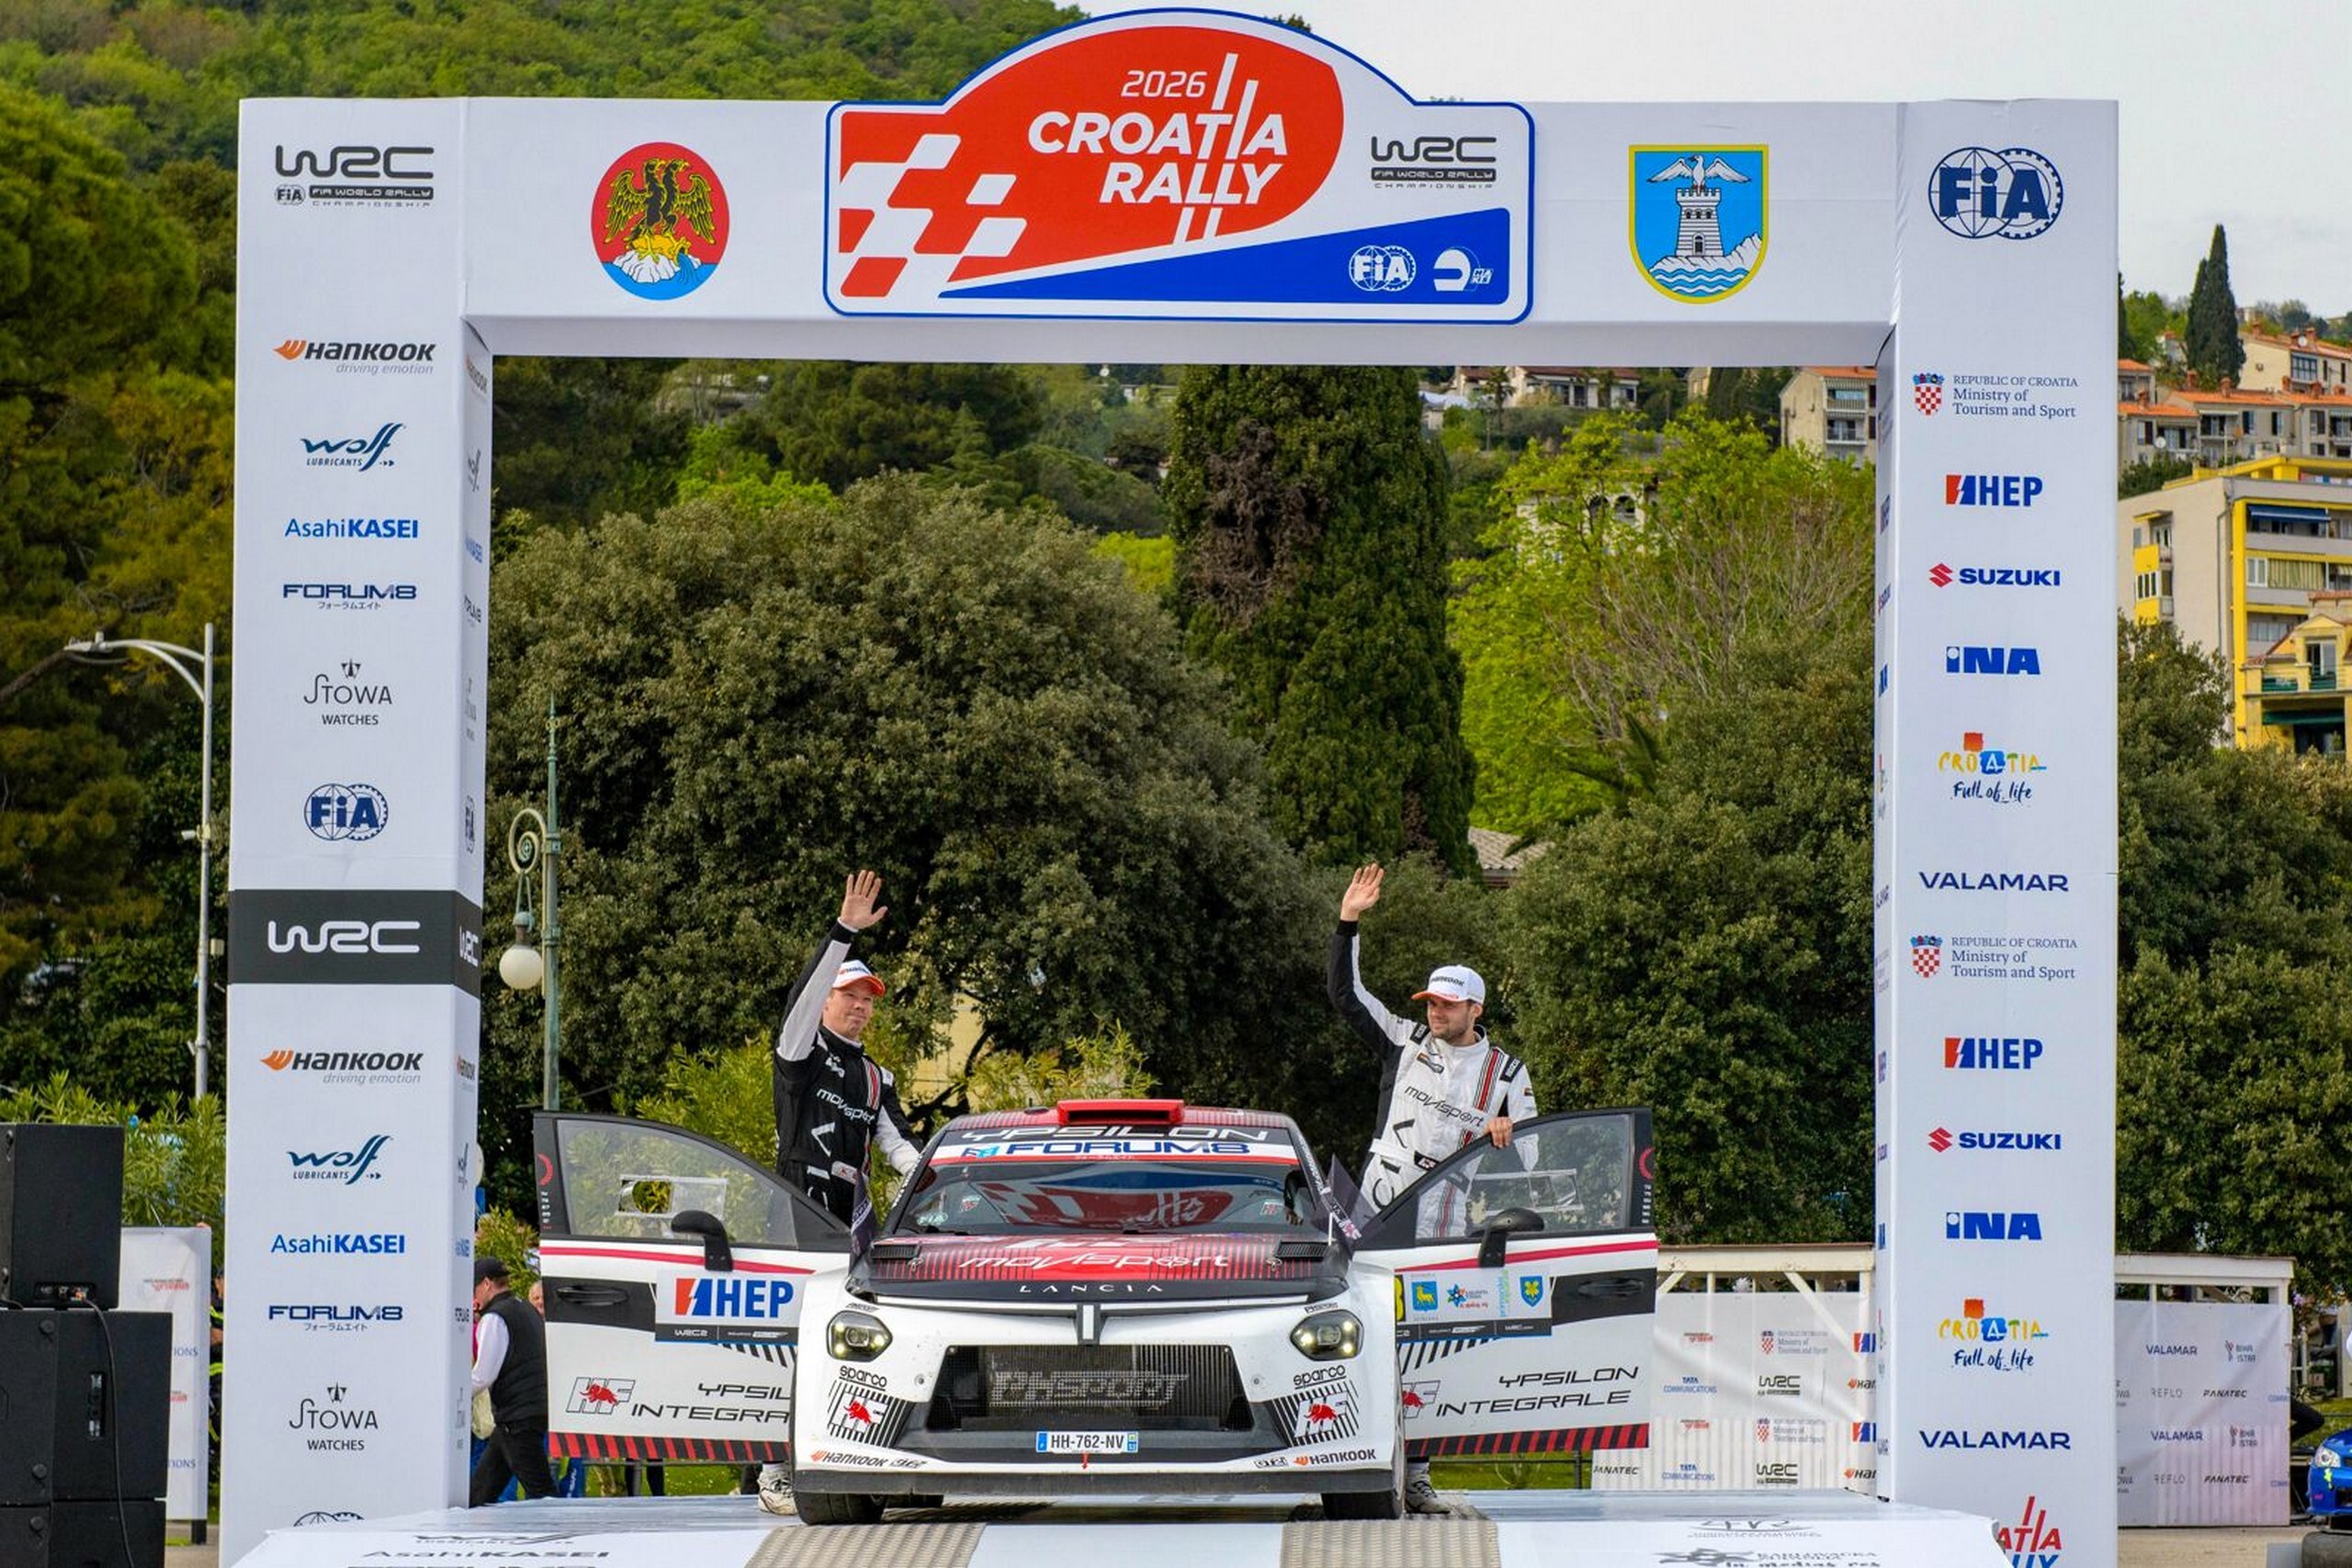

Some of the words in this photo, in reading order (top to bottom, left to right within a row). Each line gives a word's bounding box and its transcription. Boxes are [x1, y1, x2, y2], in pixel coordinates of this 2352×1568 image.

[1121, 70, 1207, 98] 2026
[1027, 111, 1288, 160] CROATIA
[1372, 136, 1498, 164] WRC
[275, 144, 435, 179] WRC
[1397, 171, 1444, 179] WORLD
[335, 187, 382, 197] WORLD
[385, 188, 431, 197] RALLY
[1100, 162, 1284, 207] RALLY
[336, 365, 379, 377] driving
[382, 365, 434, 375] emotion
[1953, 375, 2008, 387] REPUBLIC
[2010, 376, 2026, 387] OF
[2028, 377, 2079, 388] CROATIA
[1953, 389, 2012, 403] Ministry
[2014, 389, 2029, 401] of
[1953, 403, 2009, 417] Tourism
[2011, 404, 2037, 417] and
[2040, 405, 2076, 420] Sport
[307, 458, 363, 467] LUBRICANTS
[1979, 475, 2043, 507] HEP
[1959, 568, 2062, 587] SUZUKI
[283, 584, 417, 600] FORUM8
[322, 715, 379, 726] WATCHES
[1939, 750, 2048, 775] CROATIA
[1953, 781, 1983, 799] Full
[1985, 782, 2002, 802] of
[2008, 781, 2033, 802] life
[1919, 872, 2069, 893] VALAMAR
[267, 920, 421, 953] WRC
[1951, 937, 2007, 948] REPUBLIC
[2009, 937, 2025, 948] OF
[2027, 938, 2078, 949] CROATIA
[1951, 950, 2010, 964] Ministry
[2013, 950, 2028, 963] of
[1951, 965, 2007, 978] Tourism
[2010, 965, 2035, 979] and
[2039, 966, 2075, 981] Sport
[1978, 1037, 2043, 1070] HEP
[323, 1074, 366, 1086] driving
[369, 1074, 421, 1084] emotion
[962, 1126, 1268, 1141] YPSILON
[1959, 1133, 2062, 1150] SUZUKI
[1007, 1142, 1250, 1155] FORUM8
[293, 1171, 349, 1179] LUBRICANTS
[1020, 1284, 1163, 1293] LANCIA
[716, 1279, 794, 1318] HEP
[268, 1305, 403, 1321] FORUM8
[1939, 1317, 2050, 1342] CROATIA
[2146, 1345, 2198, 1356] VALAMAR
[1954, 1349, 1984, 1367] Full
[1987, 1349, 2004, 1370] of
[2010, 1348, 2034, 1371] life
[840, 1365, 888, 1388] sparco
[1294, 1365, 1346, 1385] sparco
[1499, 1367, 1638, 1388] YPSILON
[1758, 1375, 1801, 1388] WRC
[698, 1382, 791, 1401] YPSIL
[2203, 1390, 2247, 1399] FANATEC
[1437, 1390, 1632, 1417] INTEGRALE
[631, 1404, 791, 1424] INTEGRA
[1051, 1435, 1125, 1449] HH-762-NV
[1919, 1430, 2071, 1450] VALAMAR
[2151, 1430, 2203, 1441] VALAMAR
[307, 1440, 366, 1451] WATCHES
[1757, 1463, 1798, 1476] WRC
[2205, 1474, 2250, 1484] FANATEC
[1997, 1527, 2063, 1552] ATIA
